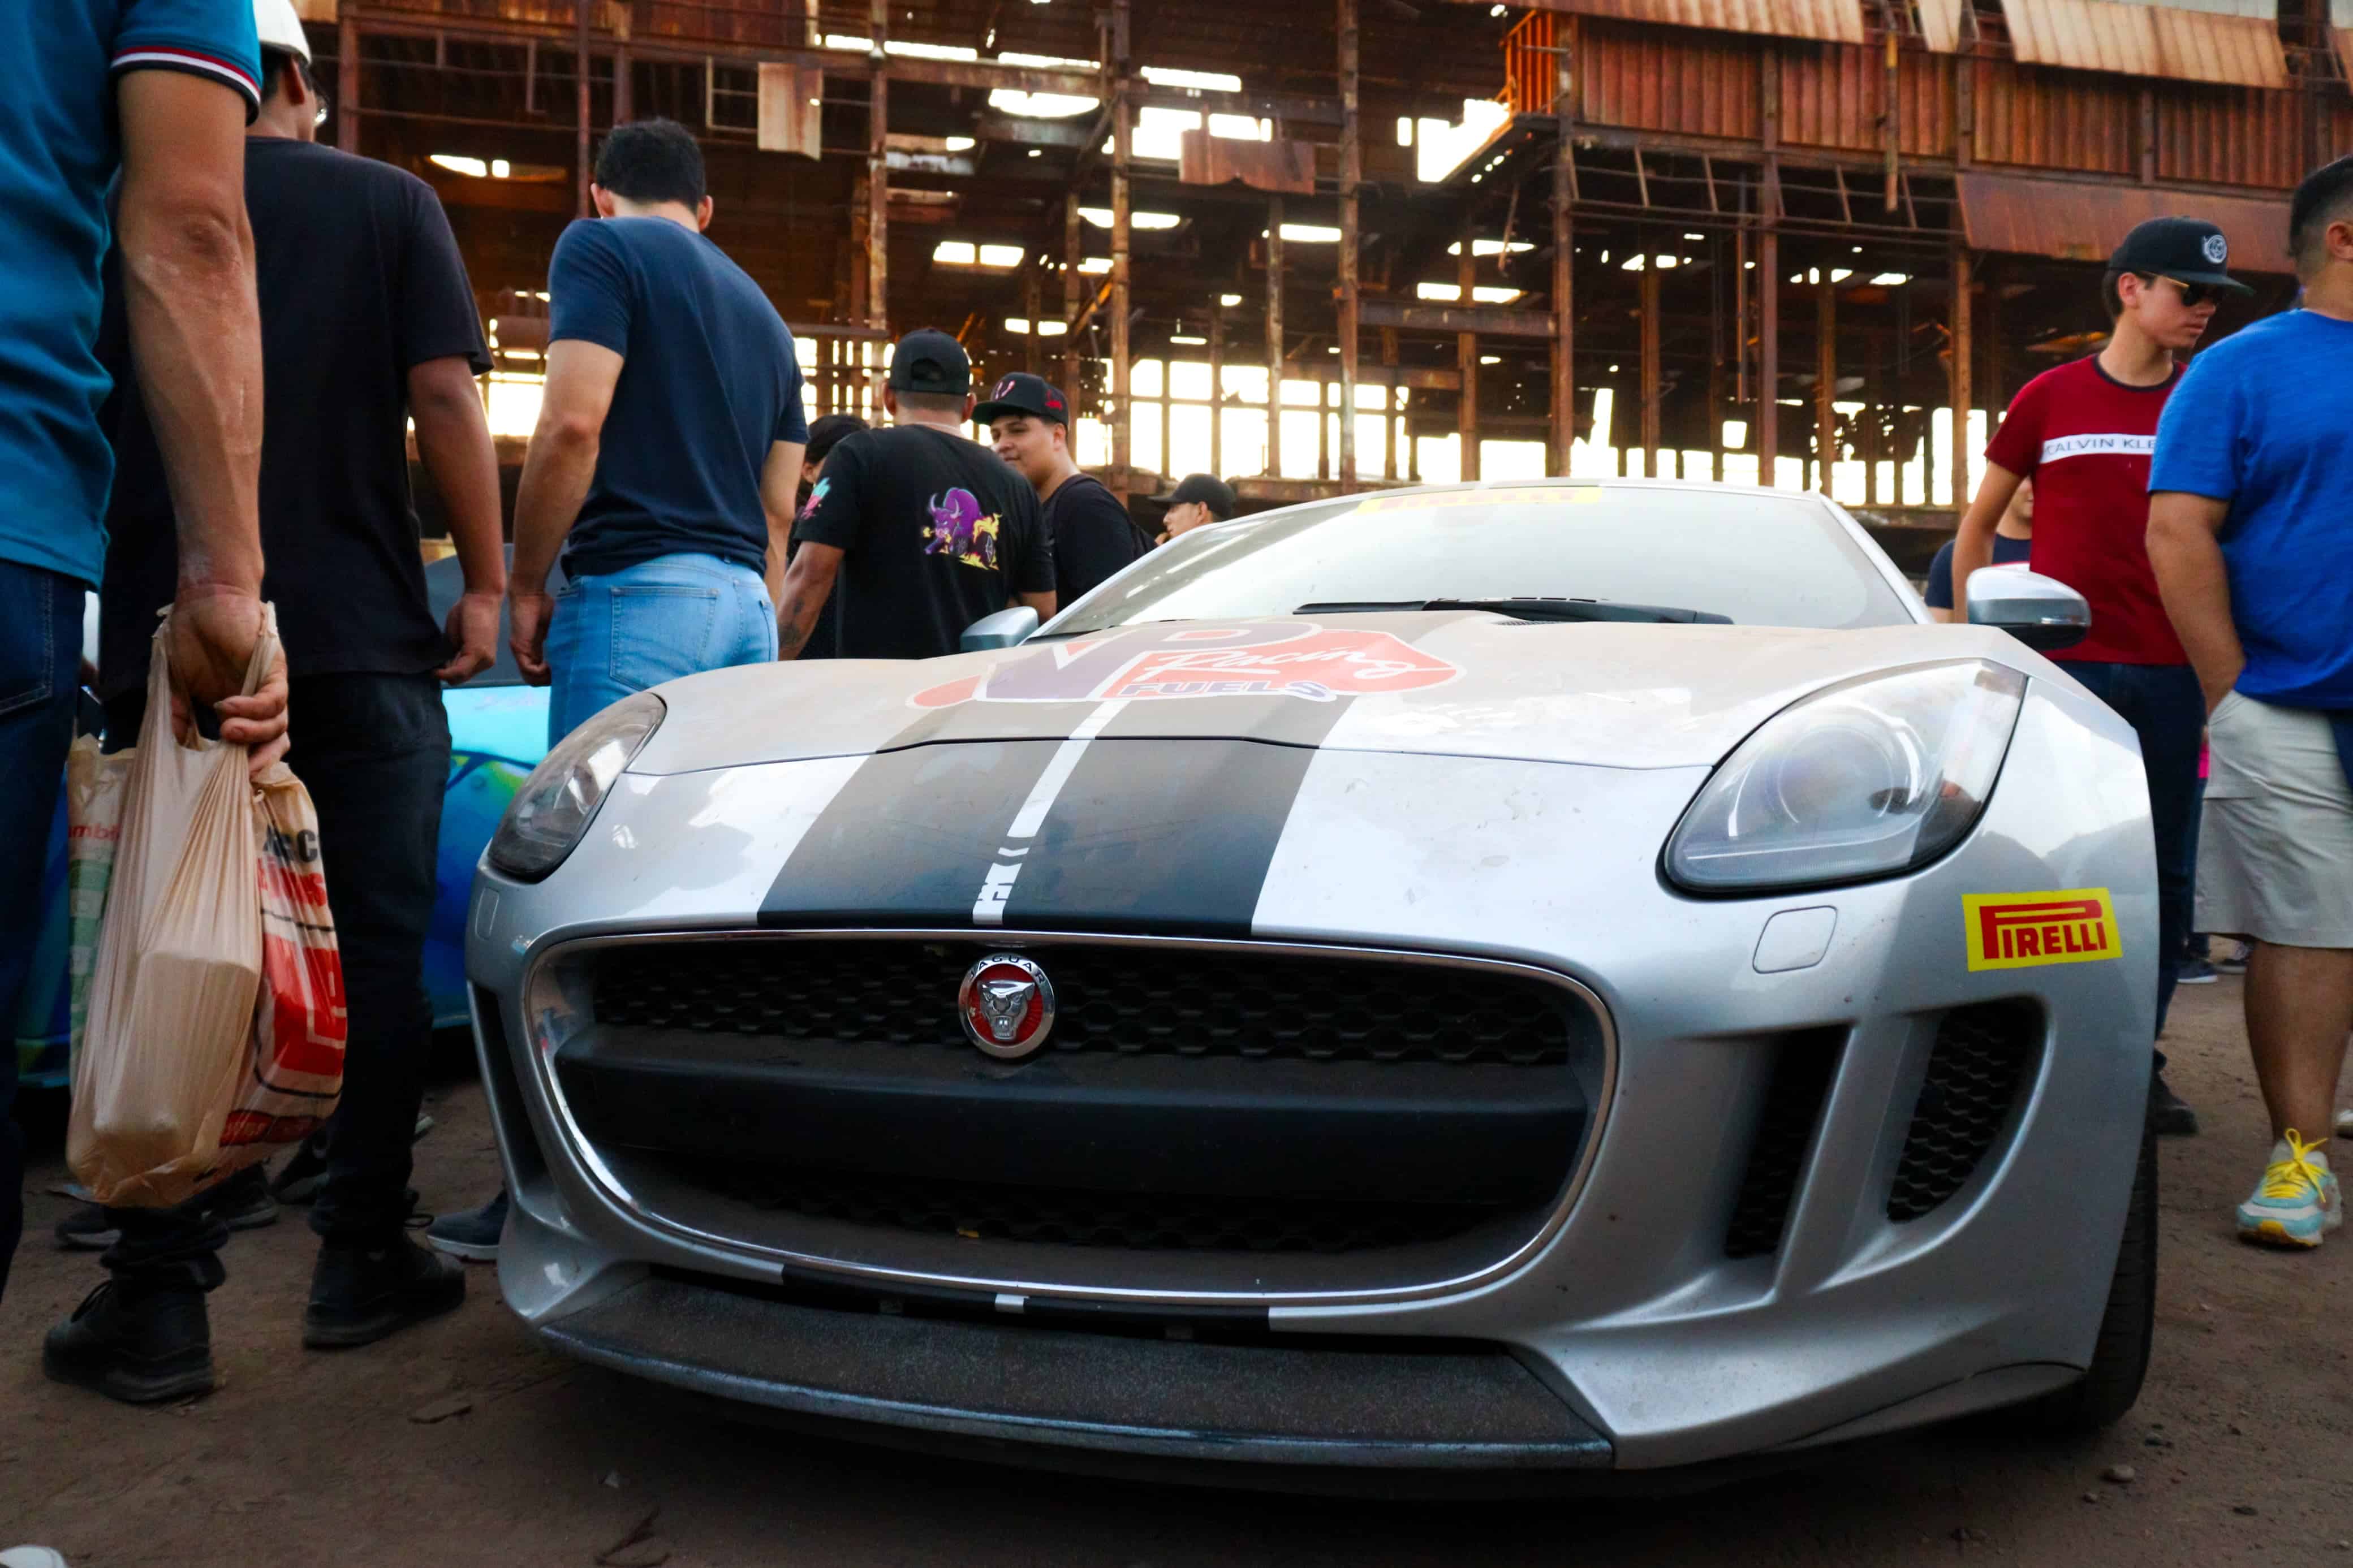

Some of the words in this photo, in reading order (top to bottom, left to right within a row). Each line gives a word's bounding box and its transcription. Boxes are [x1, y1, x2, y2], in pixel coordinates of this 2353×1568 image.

[2045, 438, 2114, 455] CALVIN
[1135, 646, 1431, 682] Racing
[1118, 680, 1333, 700] FUELS
[1979, 900, 2108, 960] PIRELLI
[969, 954, 1046, 984] JAGUAR
